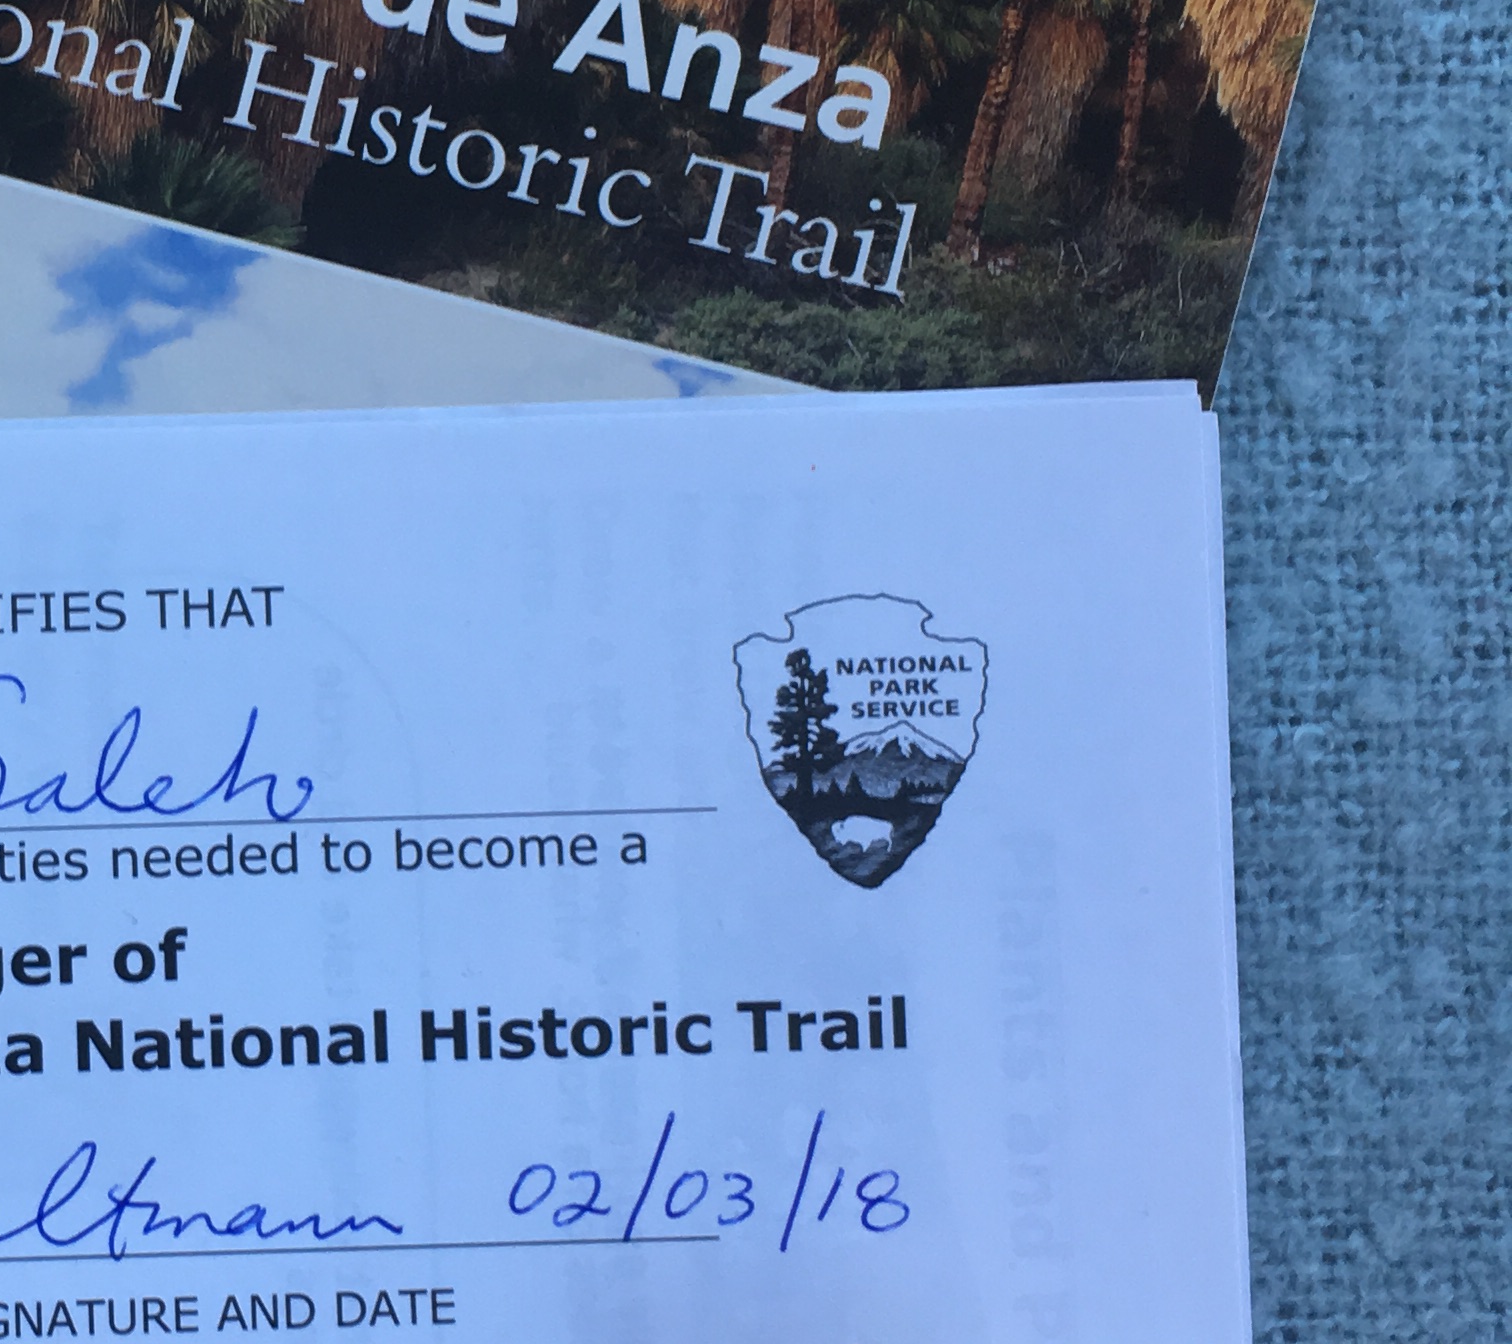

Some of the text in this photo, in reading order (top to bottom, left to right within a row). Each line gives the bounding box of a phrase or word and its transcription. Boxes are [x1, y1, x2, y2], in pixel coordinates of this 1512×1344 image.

[223, 39, 652, 228] Historic
[684, 154, 917, 300] Trail
[144, 584, 286, 632] THAT
[835, 654, 973, 676] NATIONAL
[869, 678, 939, 697] PARK
[850, 698, 960, 719] SERVICE
[110, 830, 300, 881] needed
[319, 831, 373, 875] to
[393, 826, 599, 873] become
[618, 830, 649, 867] a
[112, 925, 190, 985] of
[75, 1007, 390, 1074] National
[419, 999, 714, 1064] Historic
[734, 993, 909, 1054] Trail
[507, 1109, 909, 1252] 02/03/18
[215, 1291, 317, 1333] AND
[334, 1286, 458, 1330] DATE
